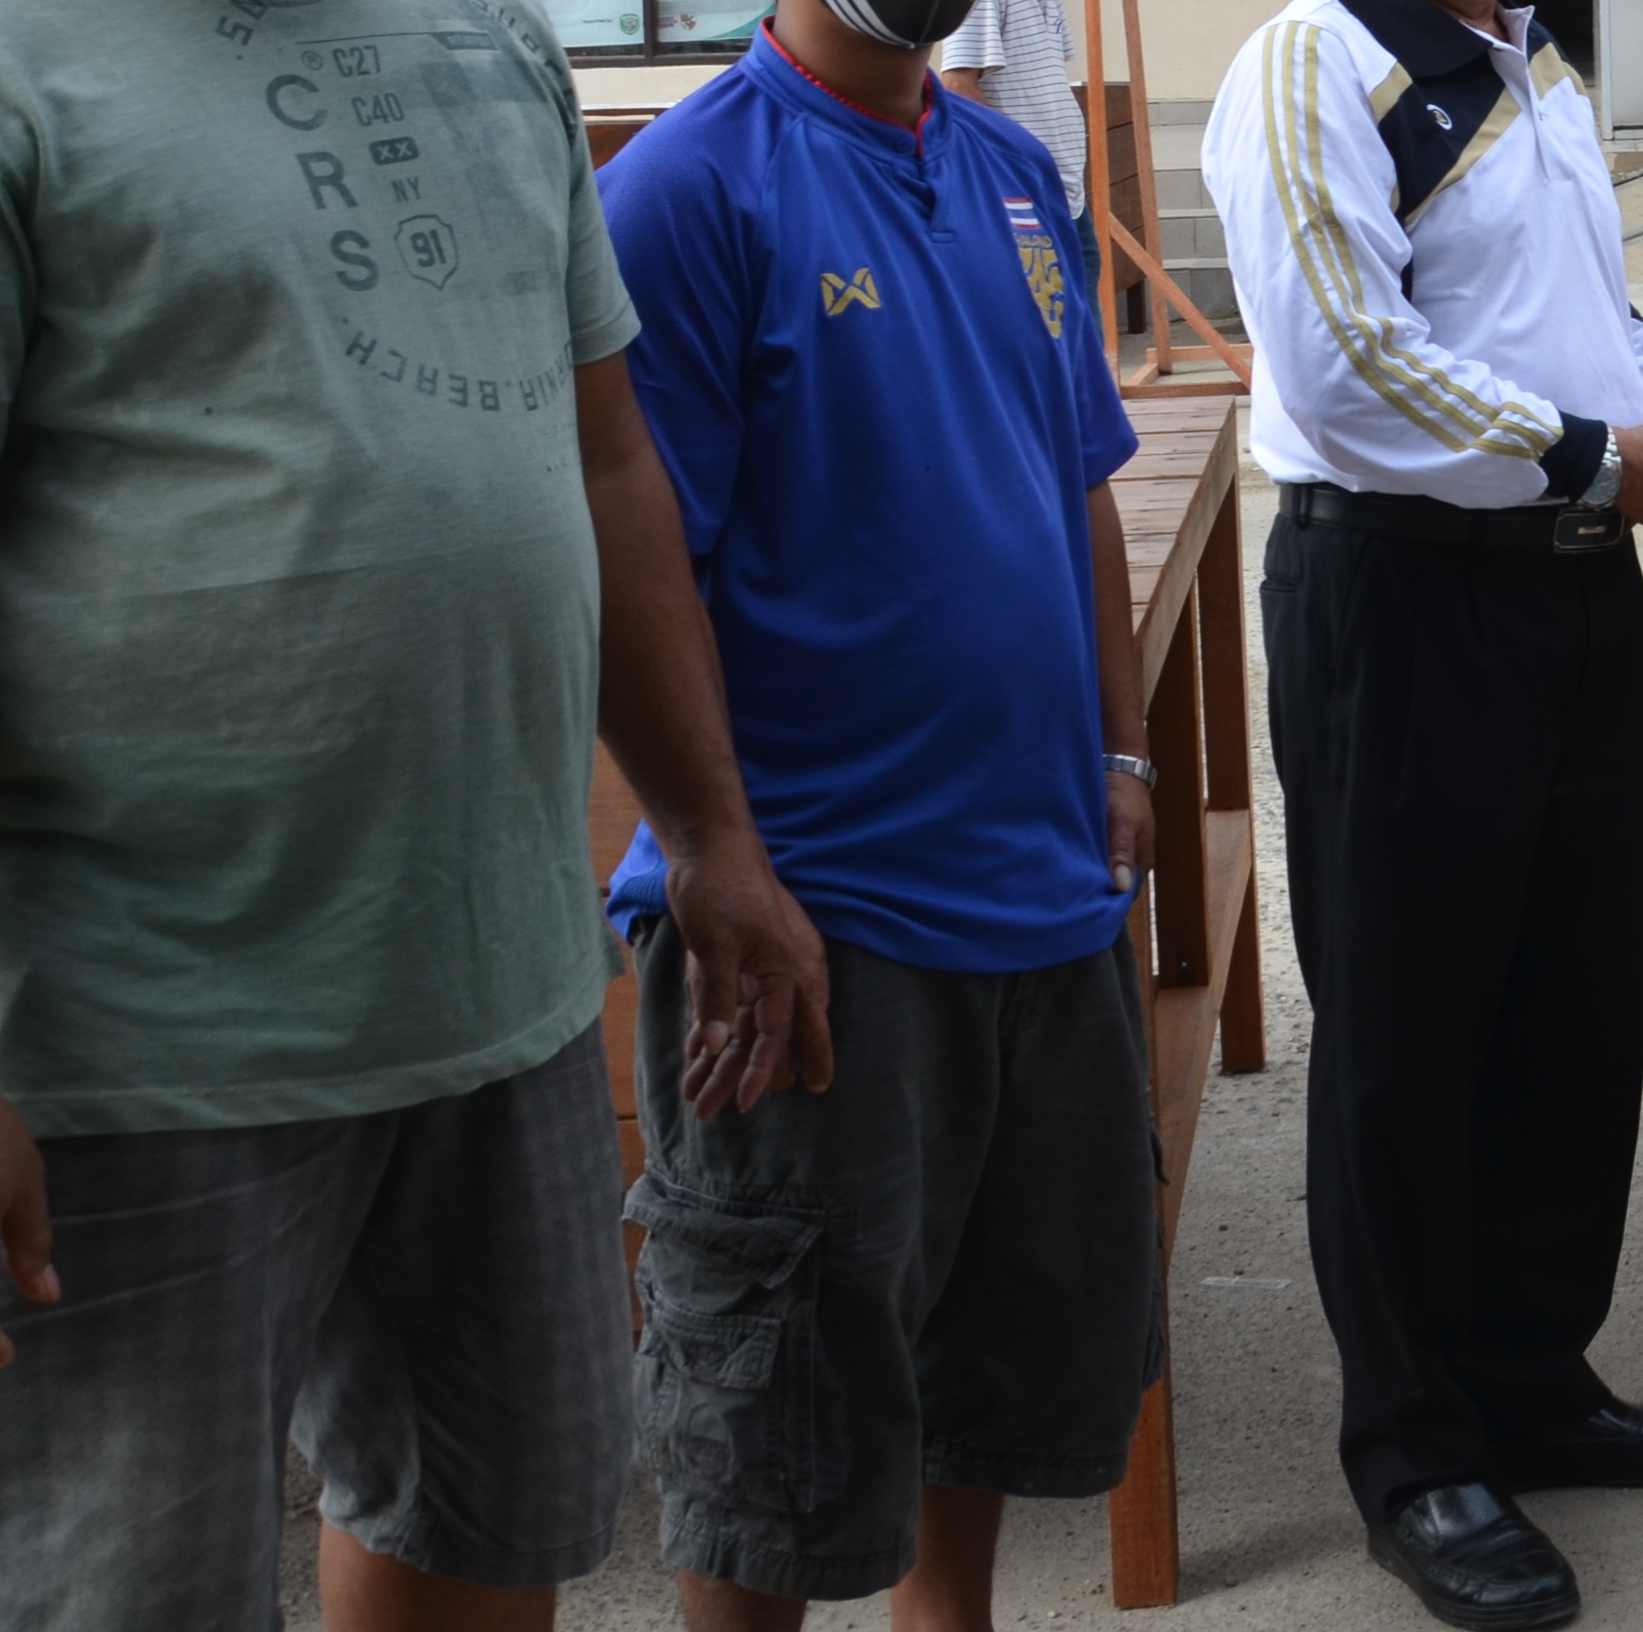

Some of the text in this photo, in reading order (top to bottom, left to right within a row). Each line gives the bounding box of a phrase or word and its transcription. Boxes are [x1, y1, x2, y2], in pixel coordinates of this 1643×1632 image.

[332, 45, 382, 79] C27
[351, 91, 405, 128] C40
[392, 175, 422, 204] NY
[409, 228, 447, 269] 91
